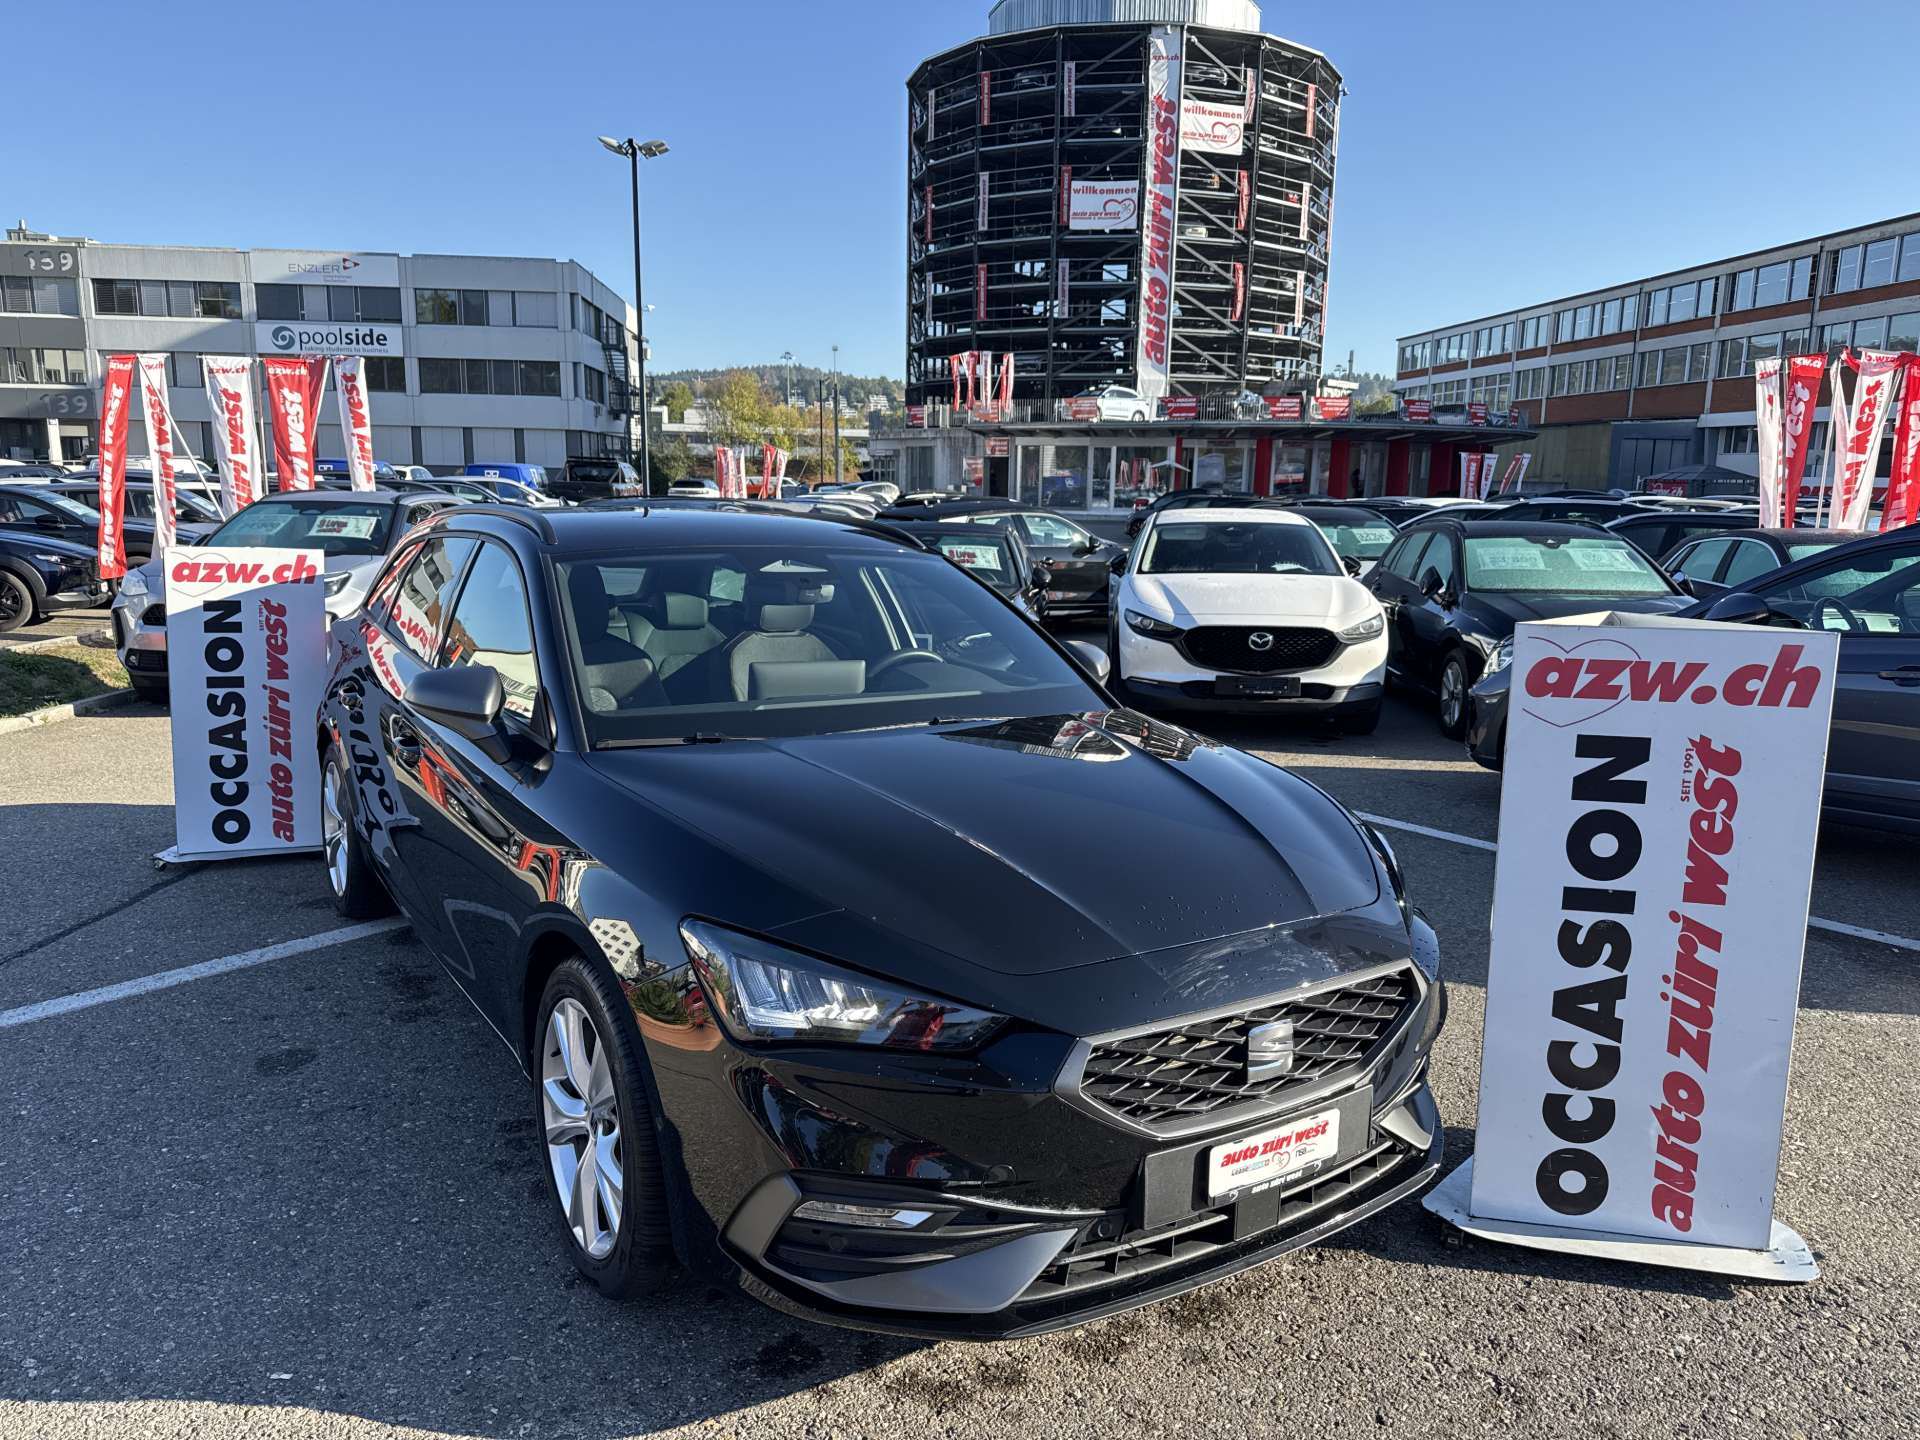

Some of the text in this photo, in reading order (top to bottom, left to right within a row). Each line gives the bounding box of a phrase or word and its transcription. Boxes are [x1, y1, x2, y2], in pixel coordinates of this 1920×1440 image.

[1183, 105, 1243, 120] willkommen
[1072, 186, 1137, 195] willkommen
[1144, 94, 1178, 366] auto züri west
[288, 263, 341, 274] ENZLER
[299, 327, 388, 351] poolside
[208, 364, 246, 377] azw.ch
[267, 364, 308, 376] azw.ch
[104, 383, 124, 447] west
[145, 385, 170, 446] west
[219, 387, 246, 455] west
[341, 372, 367, 429] west
[281, 388, 310, 491] üri west
[171, 554, 317, 585] azw.ch
[1523, 644, 1822, 709] azw.ch
[202, 600, 251, 845] OCCASION
[258, 598, 295, 843] auto züri west
[1680, 747, 1695, 803] SEIT 1991
[1535, 733, 1653, 1217] OCCASION
[1649, 734, 1743, 1234] auto züri west
[1221, 1144, 1260, 1168] auto
[1259, 1130, 1296, 1156] züri
[1294, 1119, 1329, 1145] west
